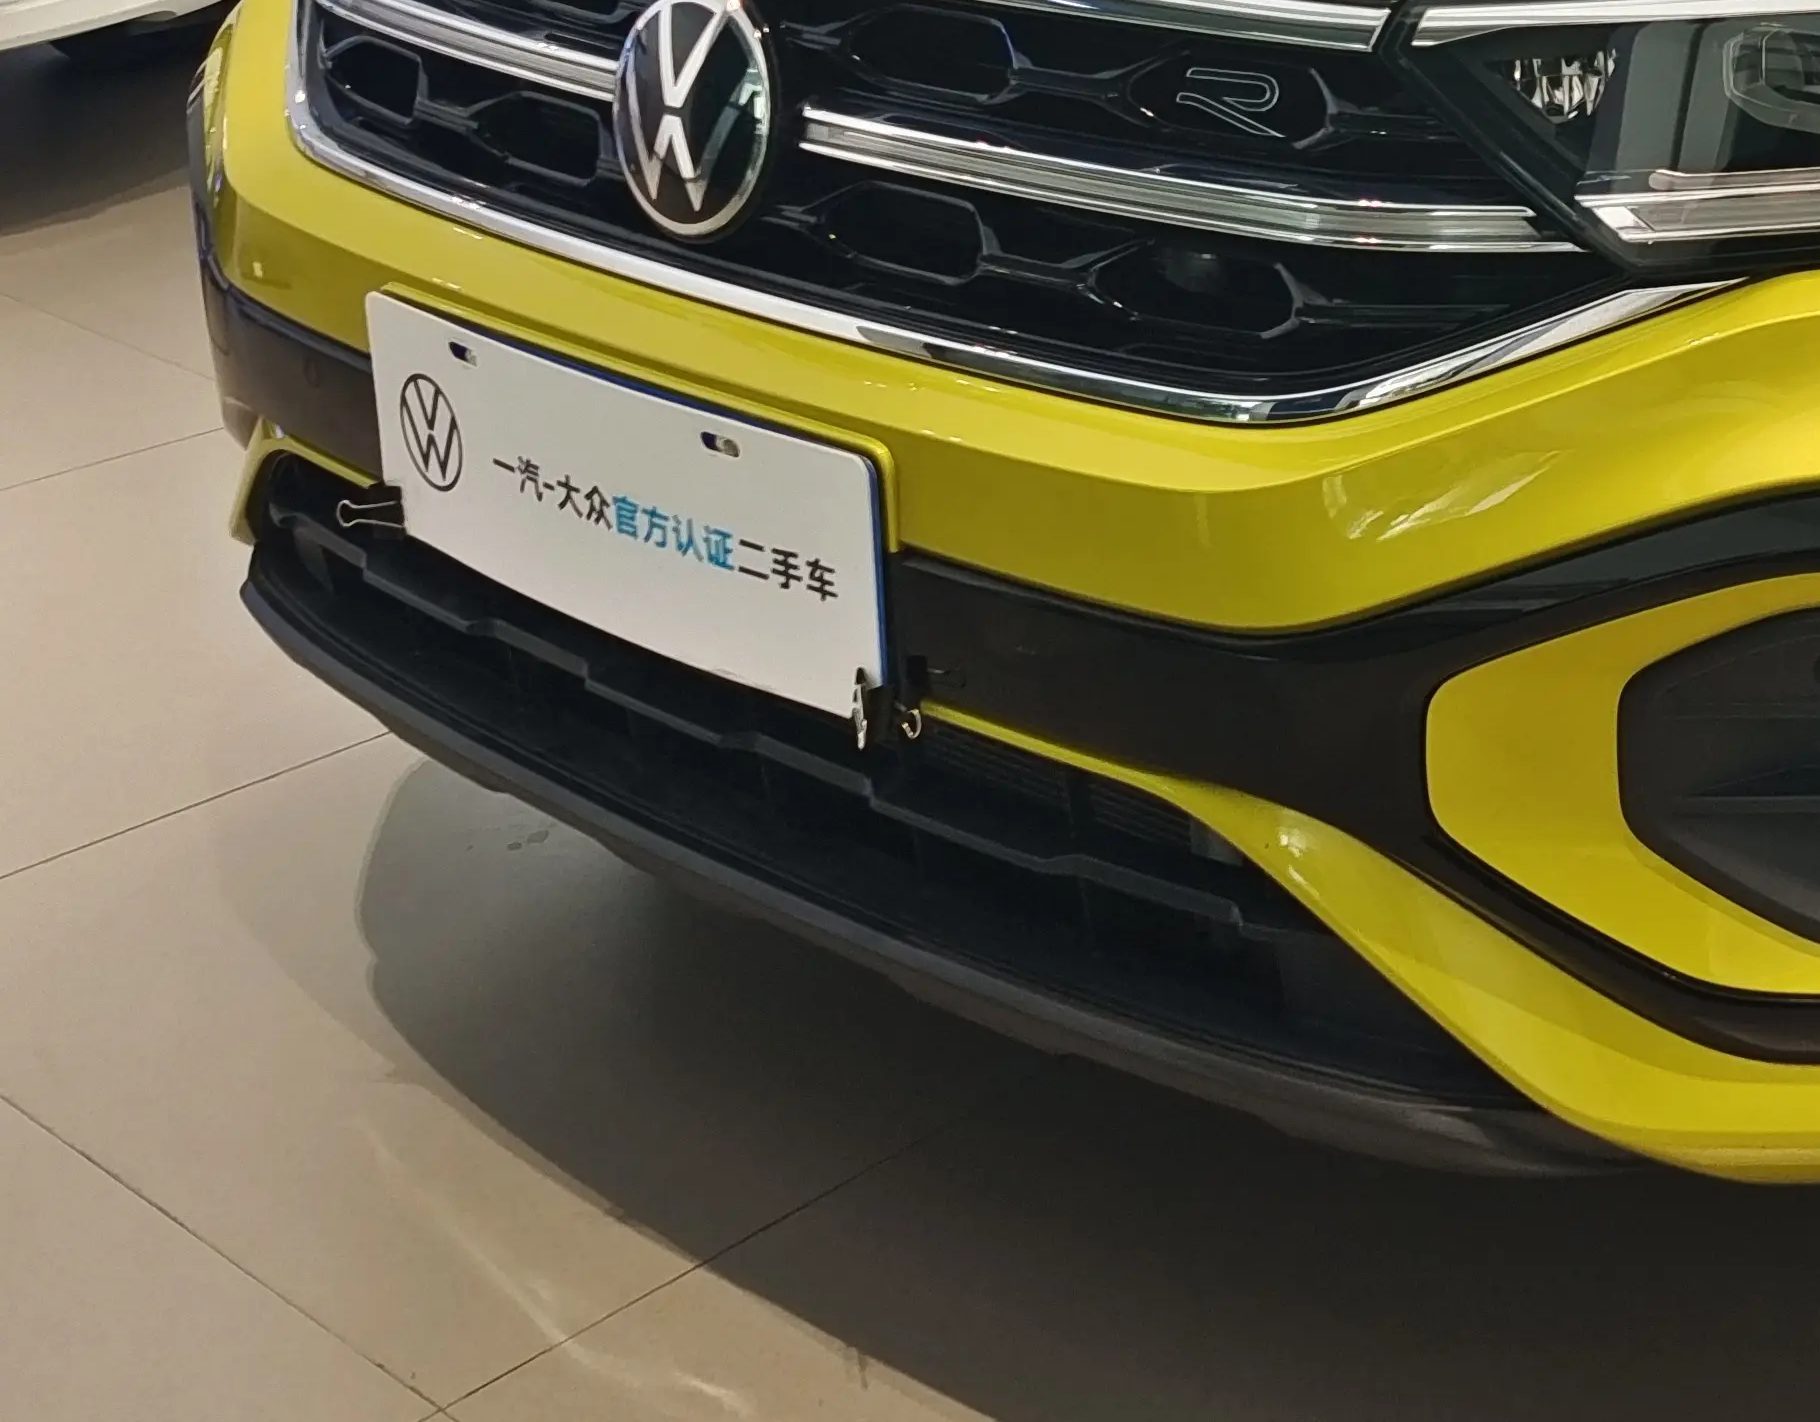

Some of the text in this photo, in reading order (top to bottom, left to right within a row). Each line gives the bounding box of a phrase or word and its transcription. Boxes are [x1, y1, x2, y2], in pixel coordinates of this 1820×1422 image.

[1176, 67, 1286, 138] R
[492, 455, 838, 602] 一汽-大众官方认证二手车
